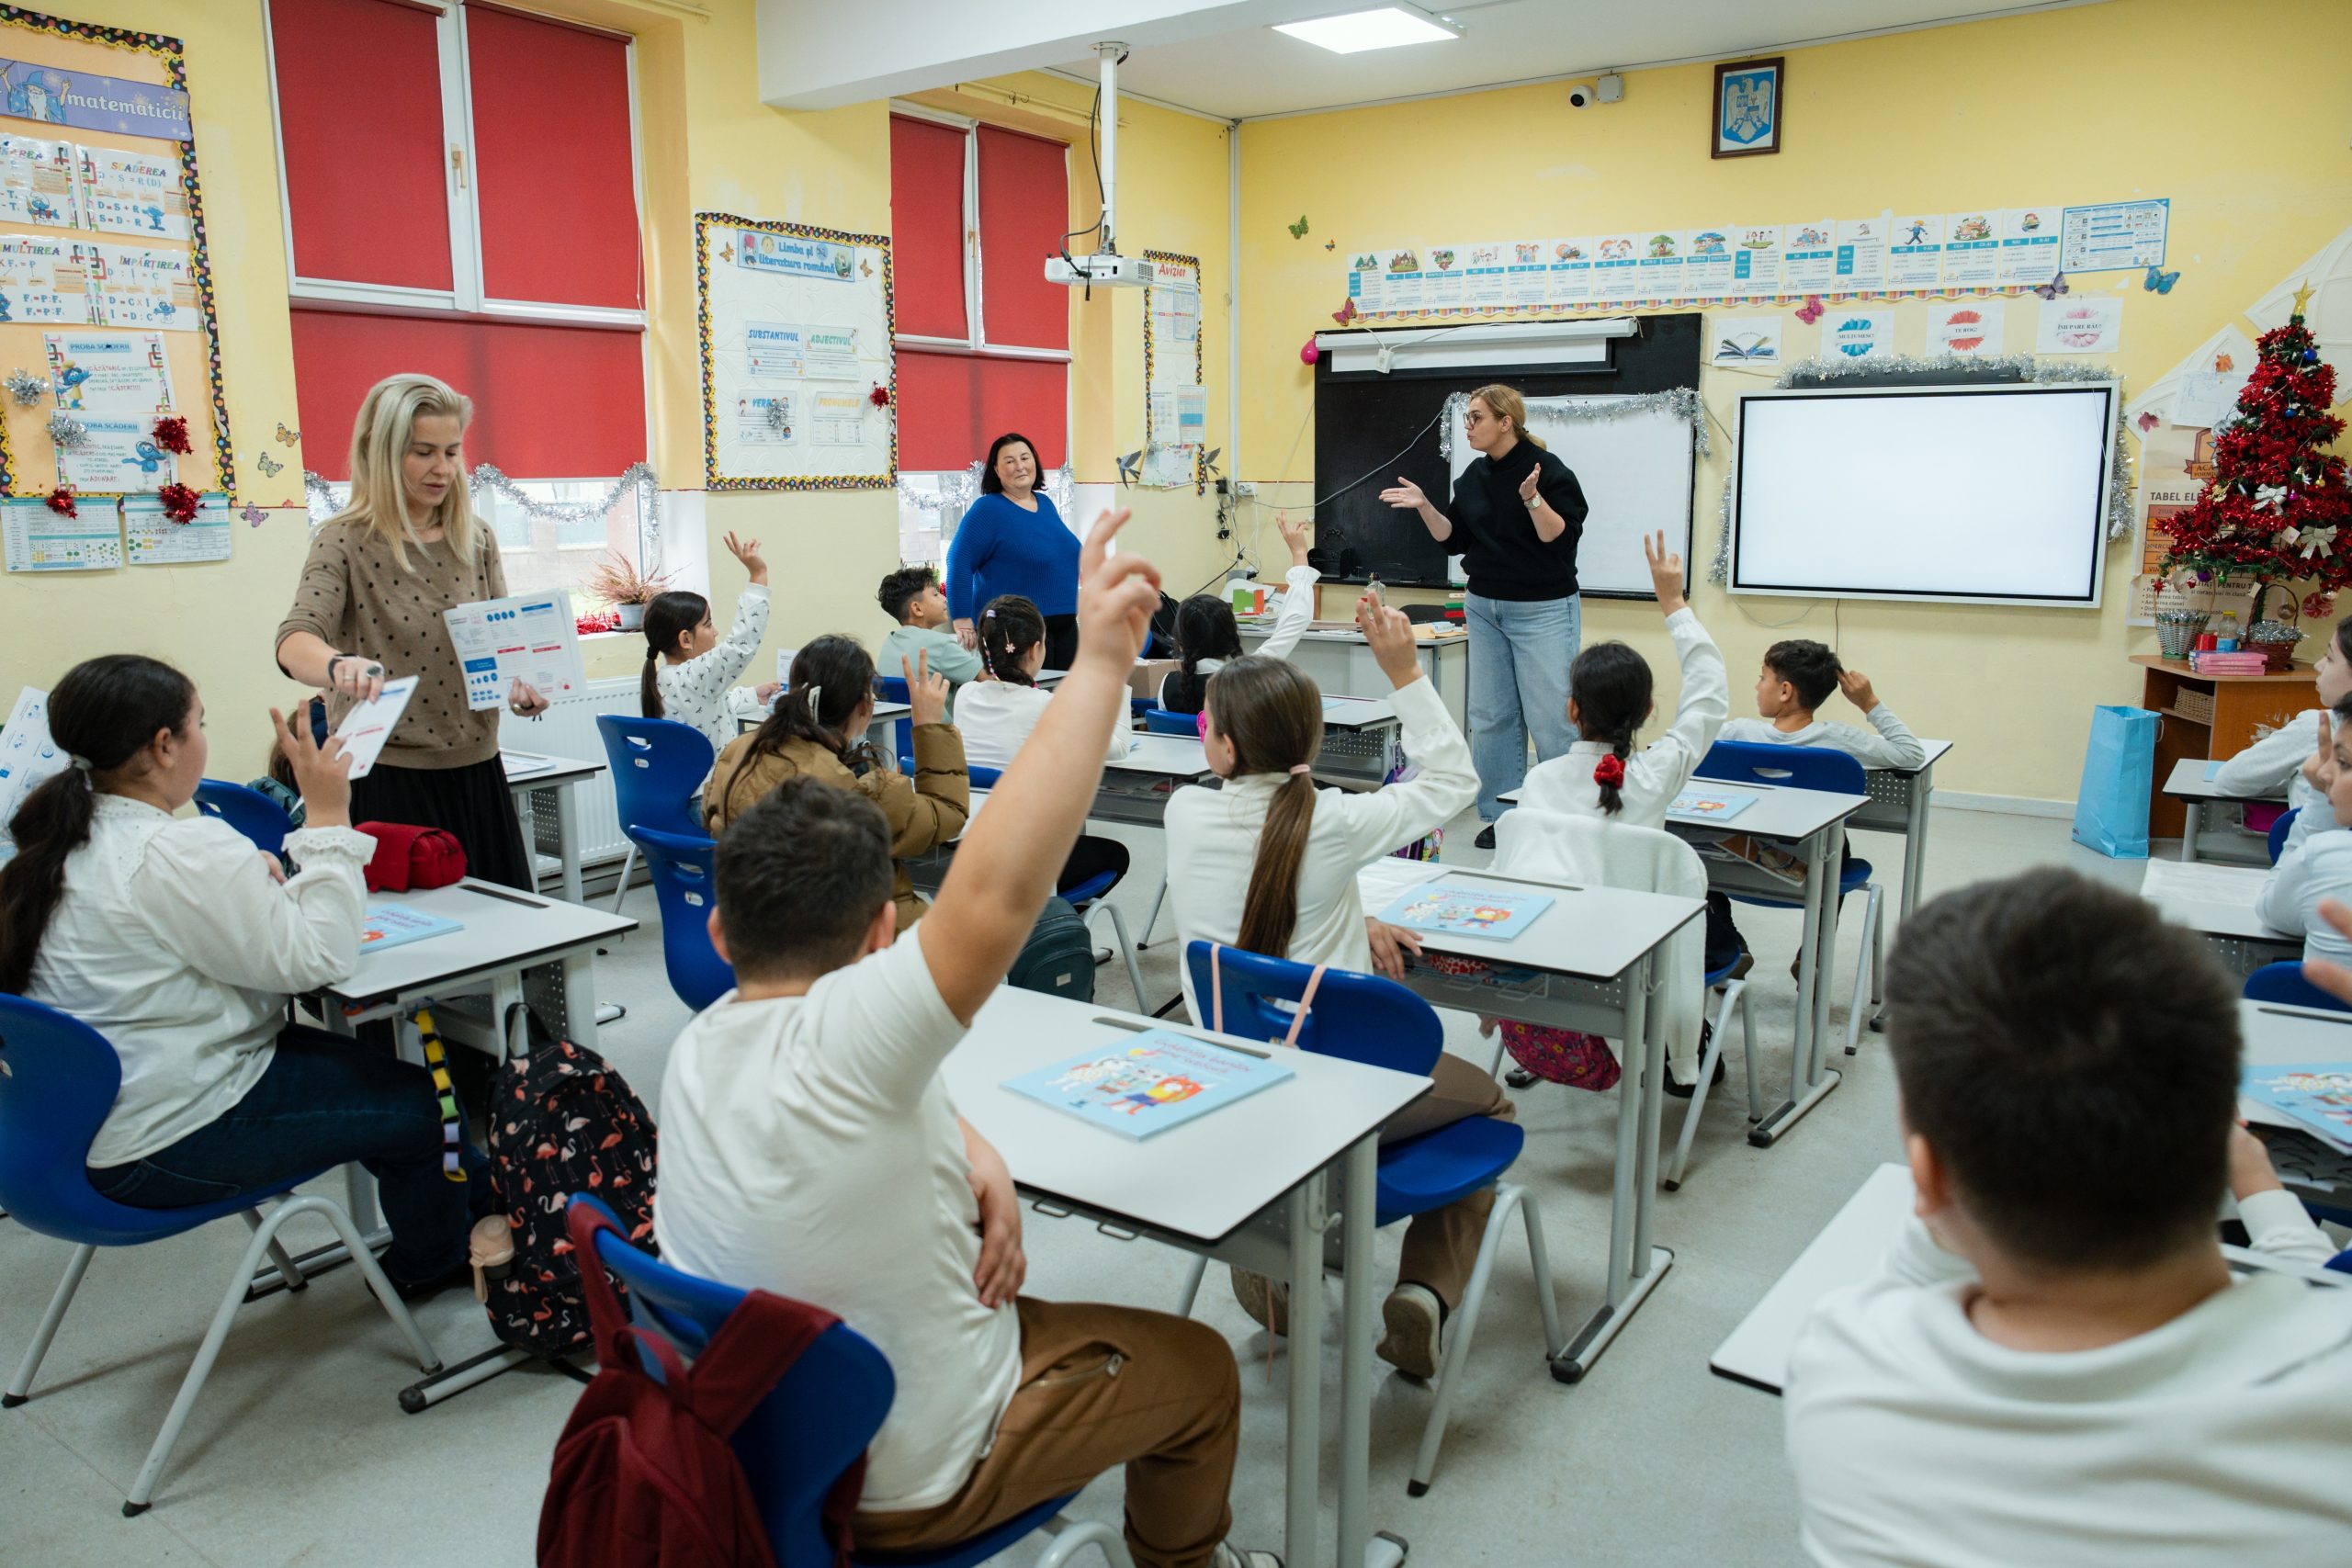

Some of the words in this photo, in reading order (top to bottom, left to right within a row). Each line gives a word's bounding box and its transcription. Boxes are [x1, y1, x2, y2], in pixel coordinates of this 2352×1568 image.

[67, 93, 185, 121] matematicii
[778, 241, 804, 255] Limba
[758, 253, 802, 269] literatura
[1158, 262, 1186, 277] Avizier
[748, 329, 799, 343] SUBSTANTIVUL
[810, 333, 852, 346] ADJECTIVUL
[2150, 491, 2181, 502] TABEL
